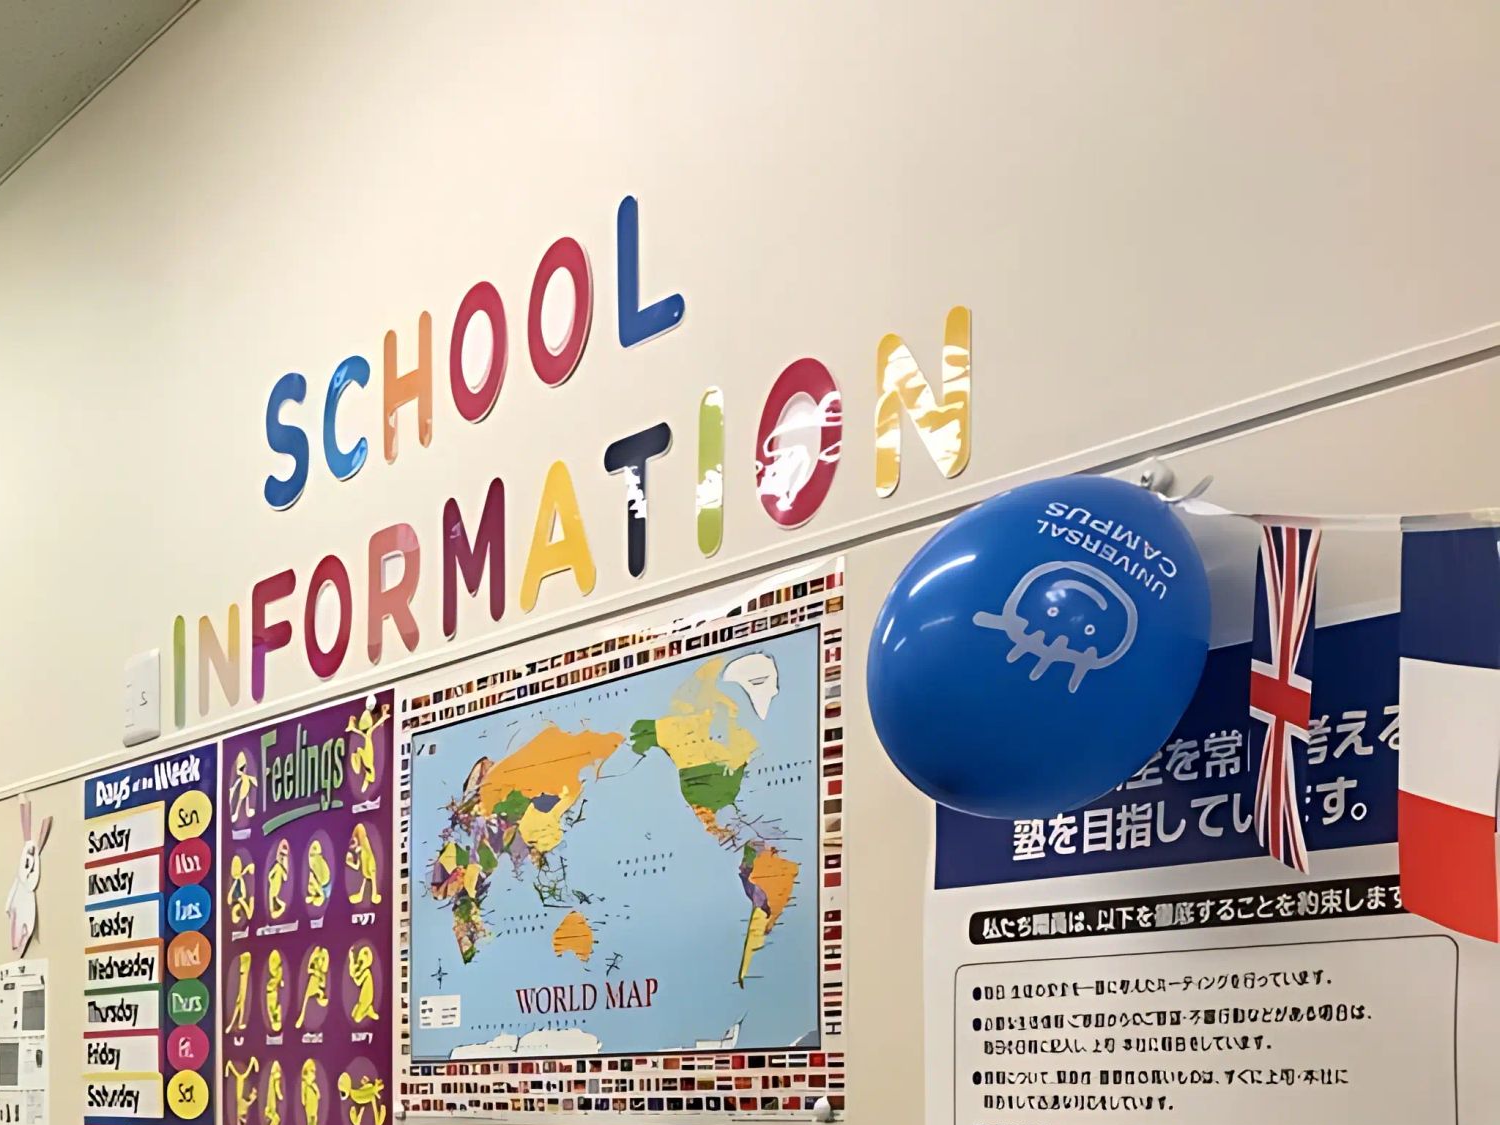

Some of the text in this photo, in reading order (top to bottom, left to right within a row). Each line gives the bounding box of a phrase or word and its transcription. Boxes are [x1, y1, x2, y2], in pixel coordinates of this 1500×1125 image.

[264, 195, 686, 512] SCHOOL
[173, 306, 972, 727] INFORMATION
[1037, 519, 1167, 600] UNIVERSAL
[1045, 502, 1178, 578] CAMPUS
[262, 724, 346, 811] Feelings
[1012, 776, 1368, 862] 塾を目指していす。
[515, 978, 659, 1015] WORLD MAP
